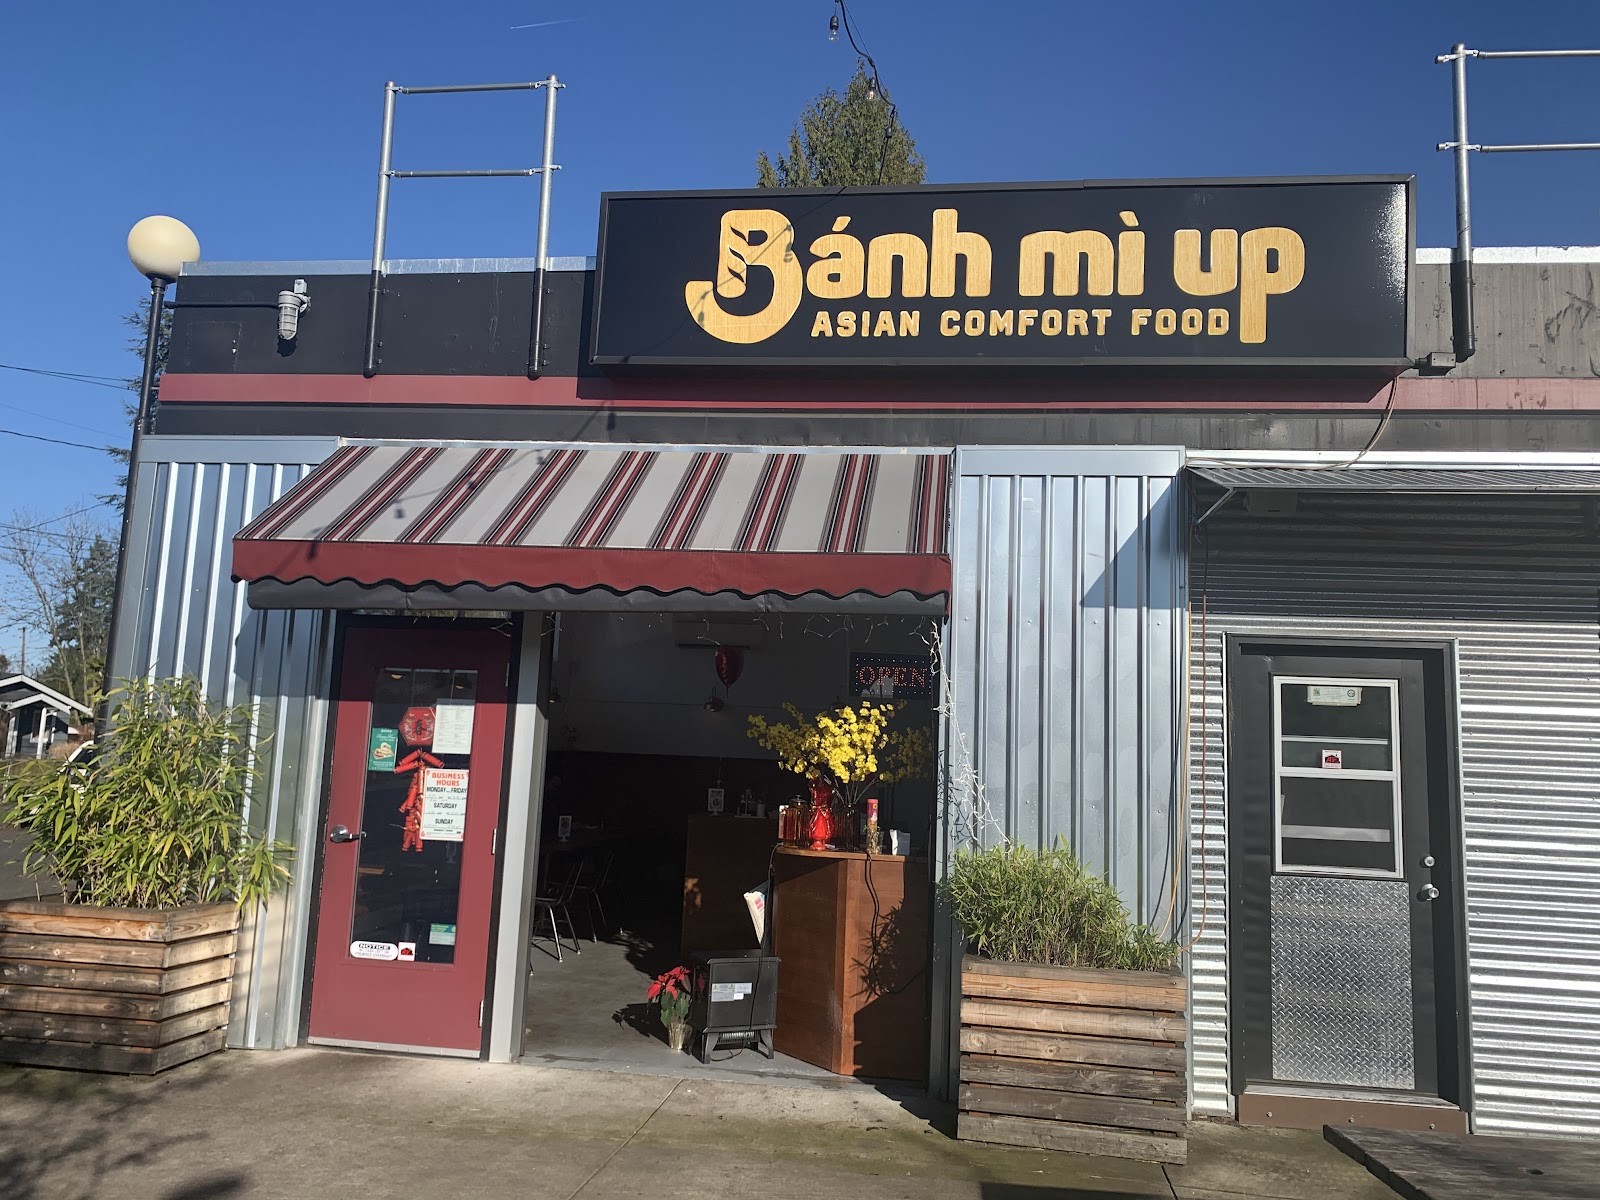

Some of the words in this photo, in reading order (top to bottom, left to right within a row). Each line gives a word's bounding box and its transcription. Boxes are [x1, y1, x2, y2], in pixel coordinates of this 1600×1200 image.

[685, 209, 992, 343] Bánh
[1019, 212, 1145, 297] mì
[1174, 228, 1305, 344] up
[811, 311, 919, 337] ASIAN
[940, 310, 1111, 336] COMFORT
[1132, 309, 1229, 336] FOOD
[859, 666, 928, 688] OPEN
[431, 772, 465, 780] BUSINESS
[436, 779, 460, 787] HOURS
